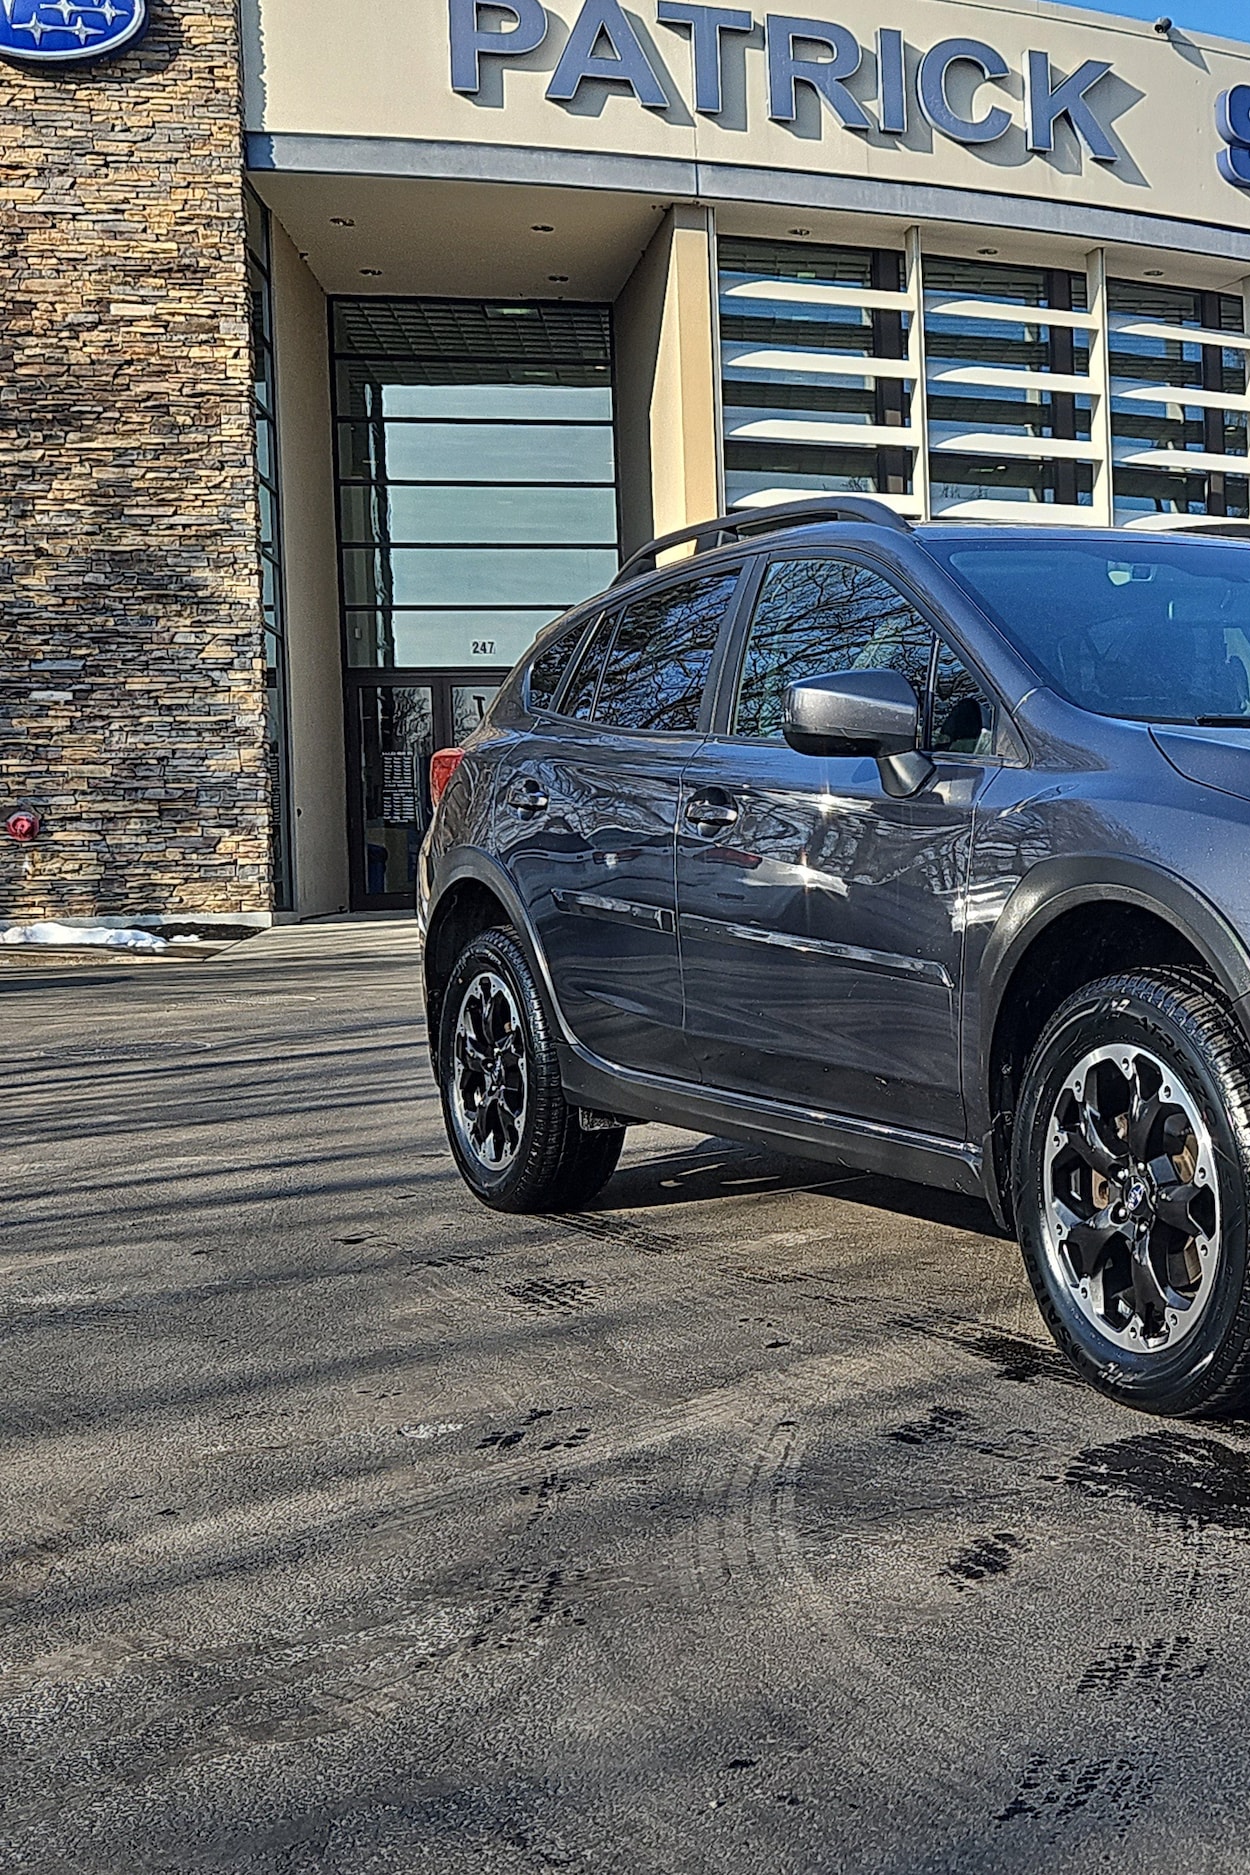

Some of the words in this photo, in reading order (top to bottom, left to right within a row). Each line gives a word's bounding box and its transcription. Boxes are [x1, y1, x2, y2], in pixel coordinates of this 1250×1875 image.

[450, 0, 1118, 163] PATRICK
[472, 641, 495, 654] 247
[1134, 1015, 1218, 1127] ATREZZO
